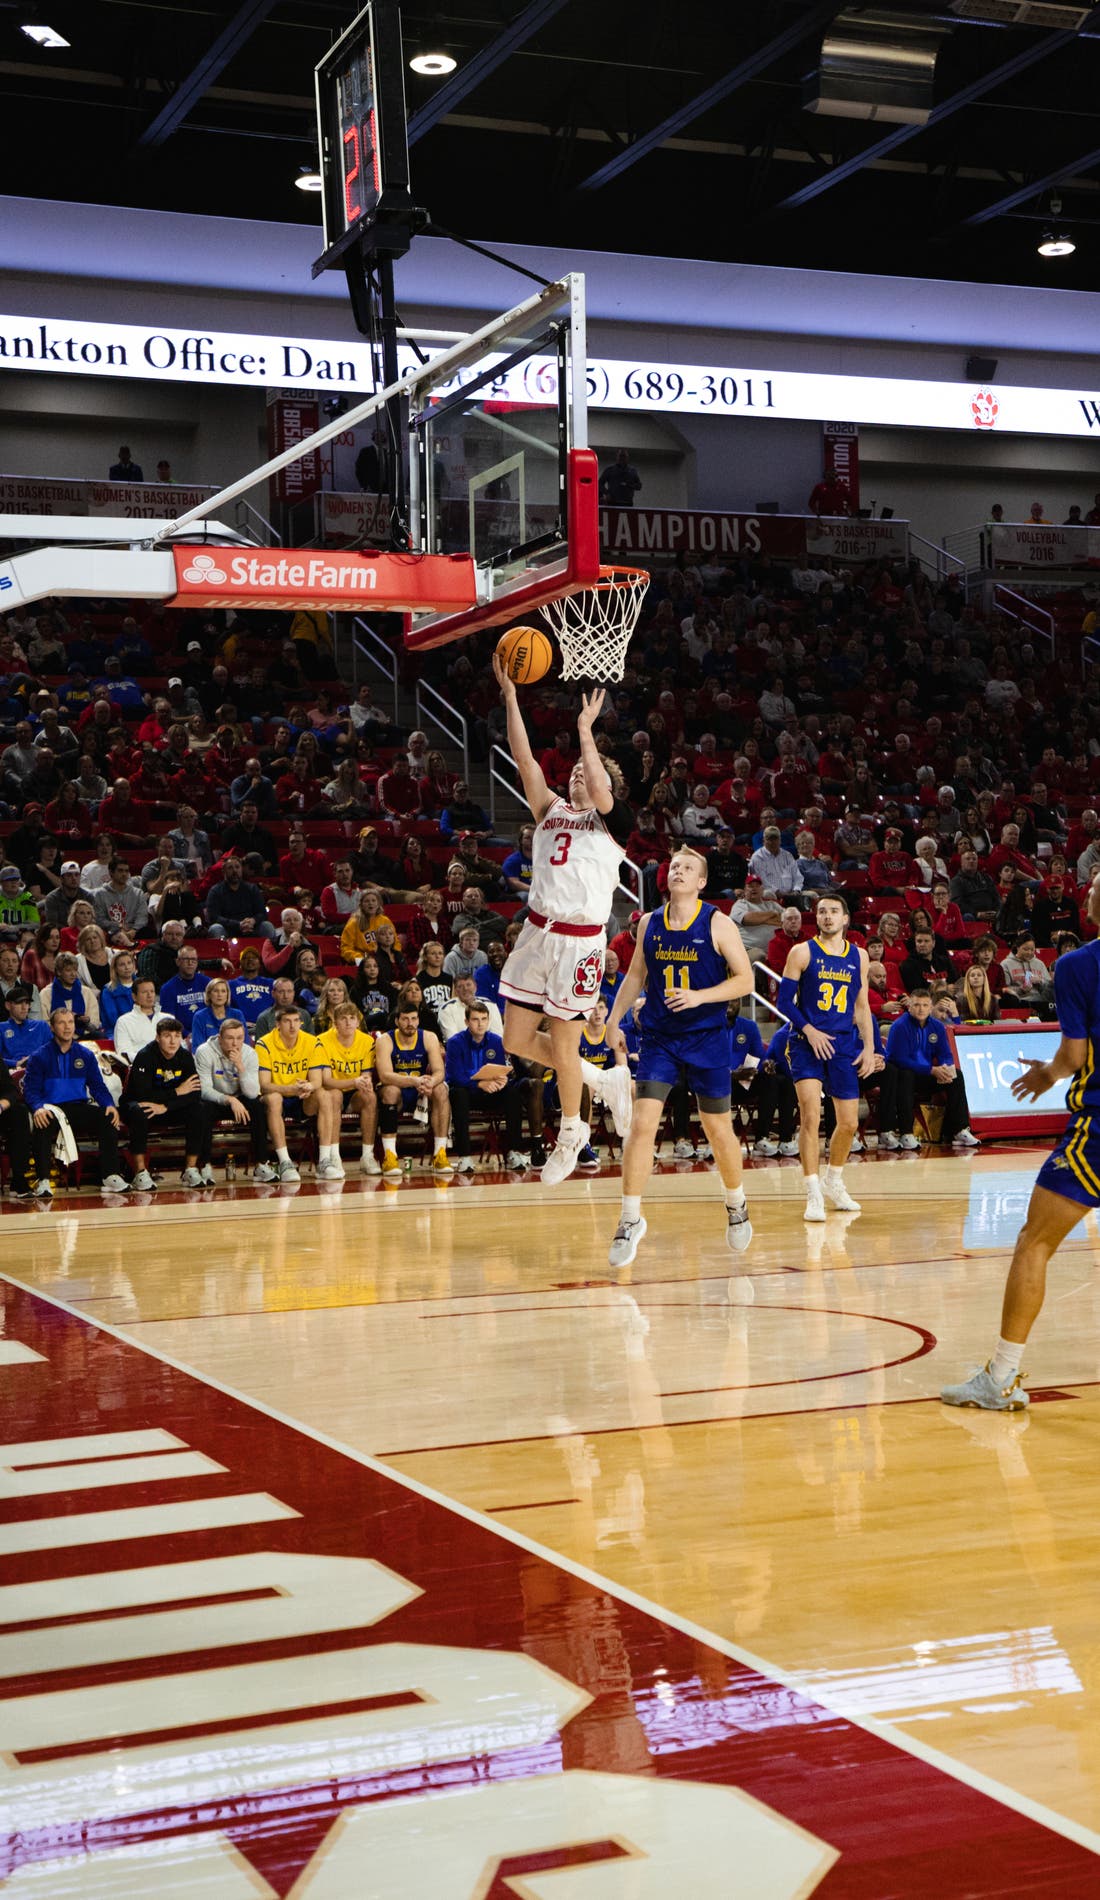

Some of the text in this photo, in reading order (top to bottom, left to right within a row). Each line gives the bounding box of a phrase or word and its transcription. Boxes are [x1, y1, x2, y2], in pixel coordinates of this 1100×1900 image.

[143, 335, 266, 376] Office:
[281, 345, 358, 381] Dan
[523, 361, 610, 404] (65)
[624, 368, 776, 408] 689-3011
[283, 408, 303, 497] BASKBALL
[17, 485, 83, 501] BASKETBALL
[92, 487, 141, 504] WOMEN'S
[328, 500, 372, 514] WOMEN'S
[1016, 531, 1067, 545] VOLLEYBALL
[1030, 546, 1055, 561] 2016
[549, 832, 572, 866] 3
[655, 943, 699, 962] Jackrabbits
[663, 964, 690, 997] 11
[818, 965, 853, 983] Jackrabbits
[817, 982, 848, 1014] 34
[273, 1058, 308, 1075] STATE
